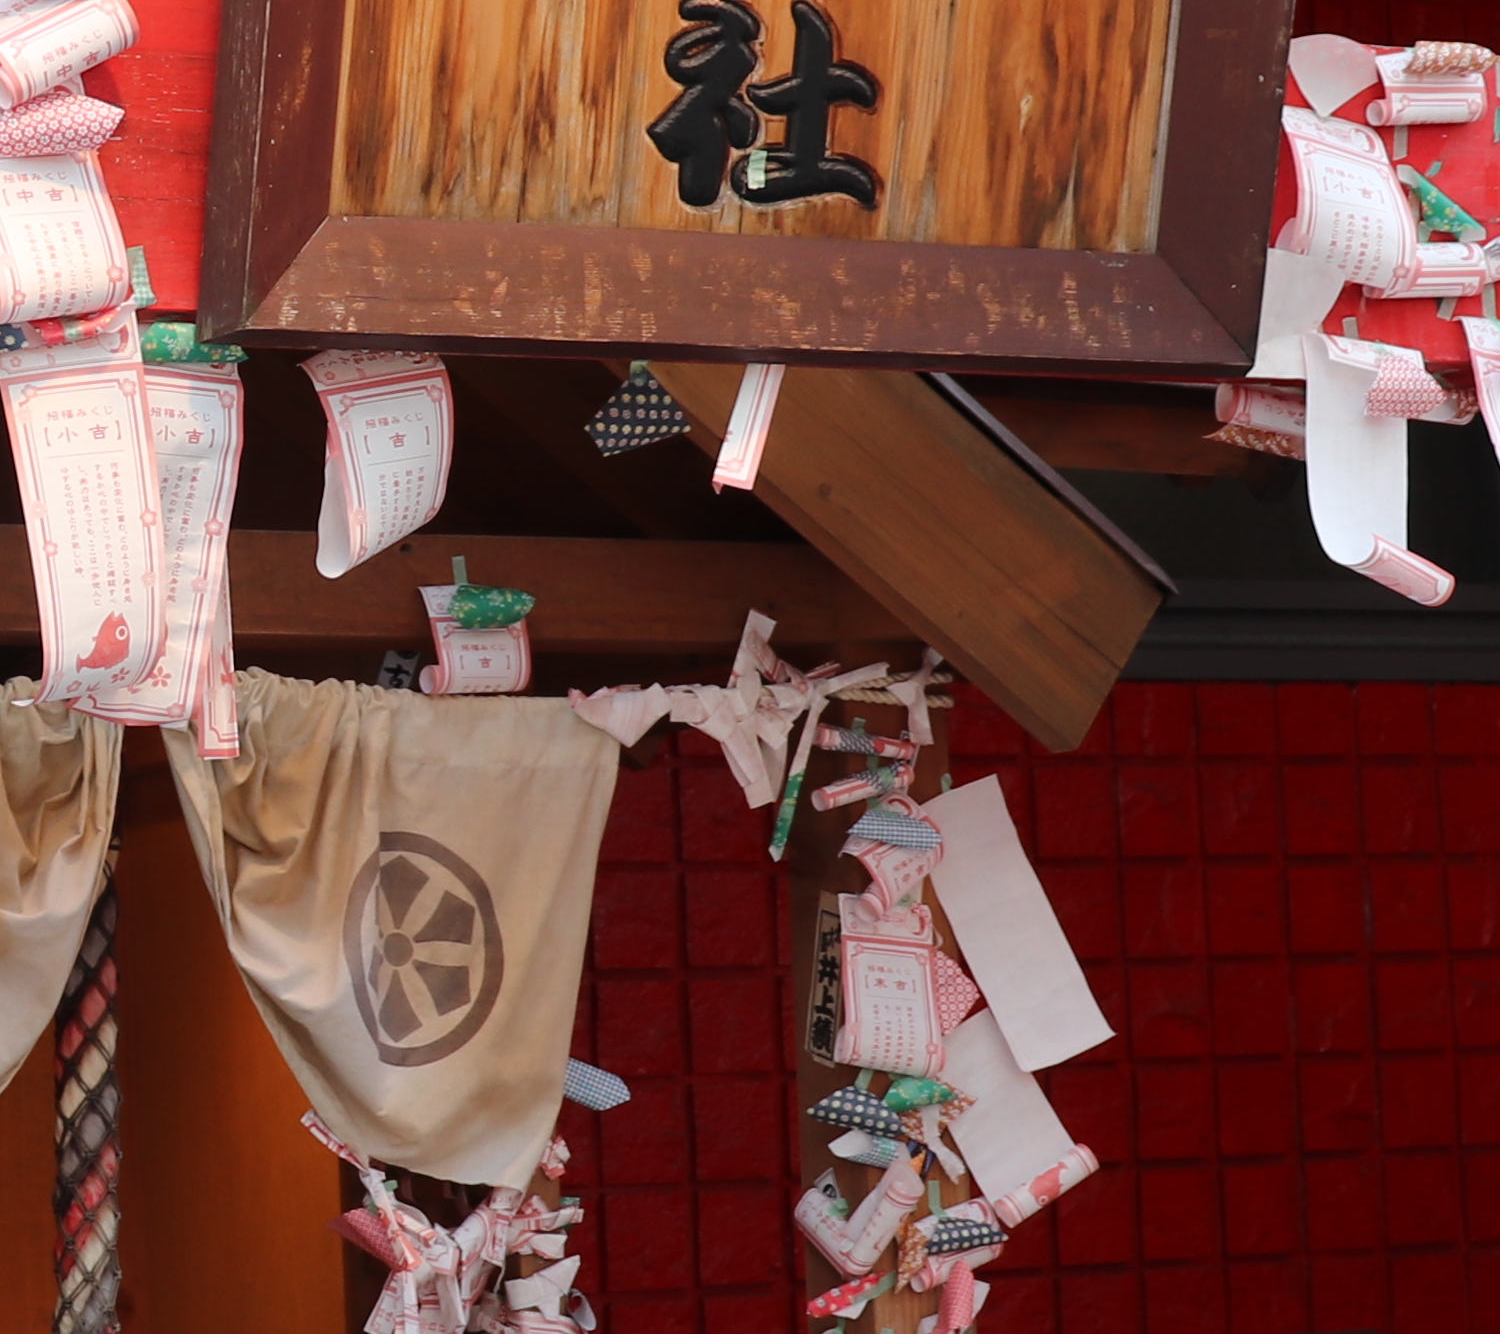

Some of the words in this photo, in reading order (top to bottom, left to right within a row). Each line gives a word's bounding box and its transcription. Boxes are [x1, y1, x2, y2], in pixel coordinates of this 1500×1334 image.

[3, 170, 68, 184] 招福みくじ
[46, 405, 114, 422] 招福みくじ
